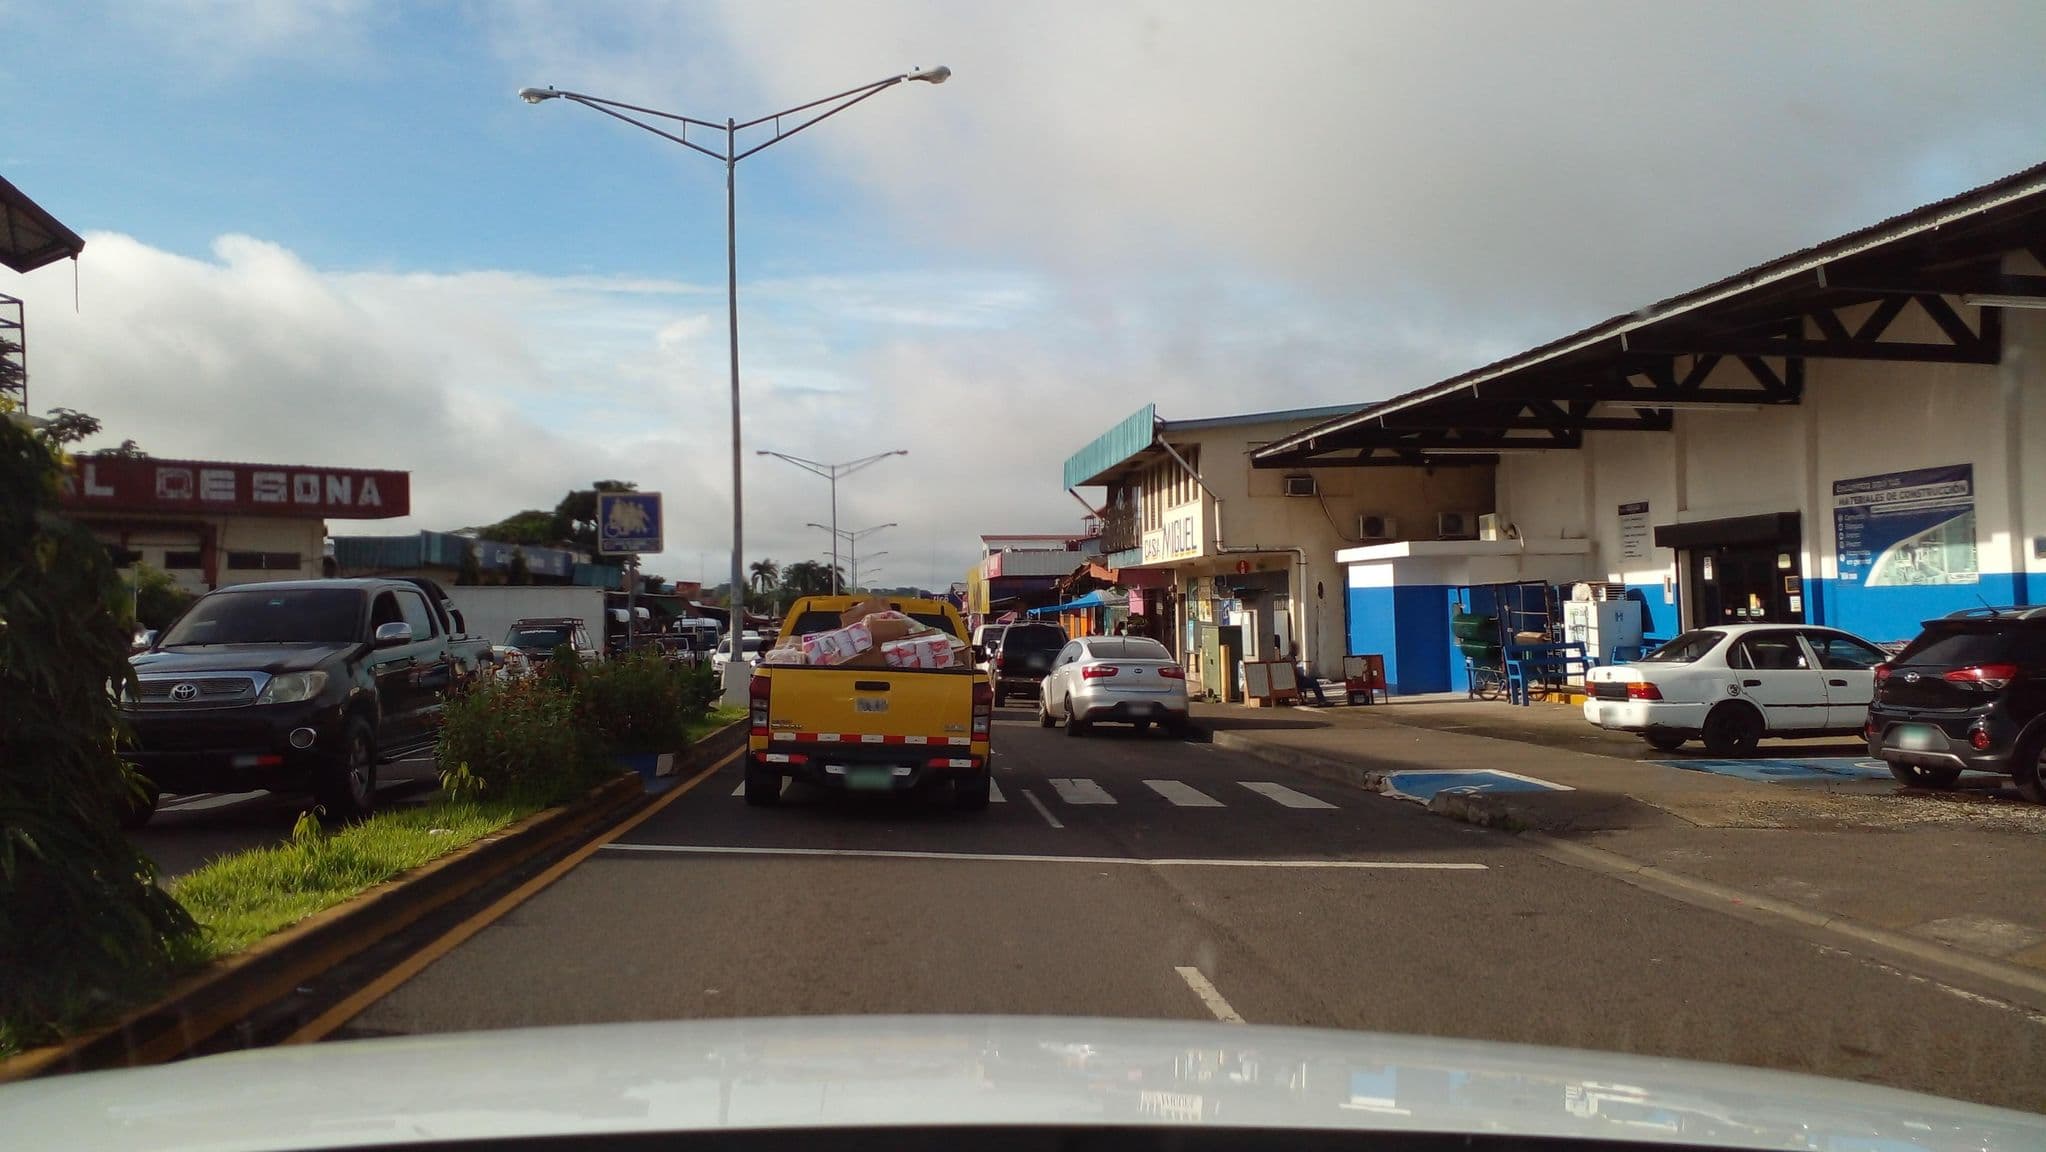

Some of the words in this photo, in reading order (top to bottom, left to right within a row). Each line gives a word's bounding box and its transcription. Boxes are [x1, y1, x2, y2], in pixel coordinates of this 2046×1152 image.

[156, 467, 236, 500] DE
[252, 471, 382, 505] SONA
[1838, 494, 1885, 505] MATERIALES
[1886, 492, 1897, 501] DE
[1145, 538, 1161, 558] CASA
[1162, 516, 1197, 560] MIGUEL
